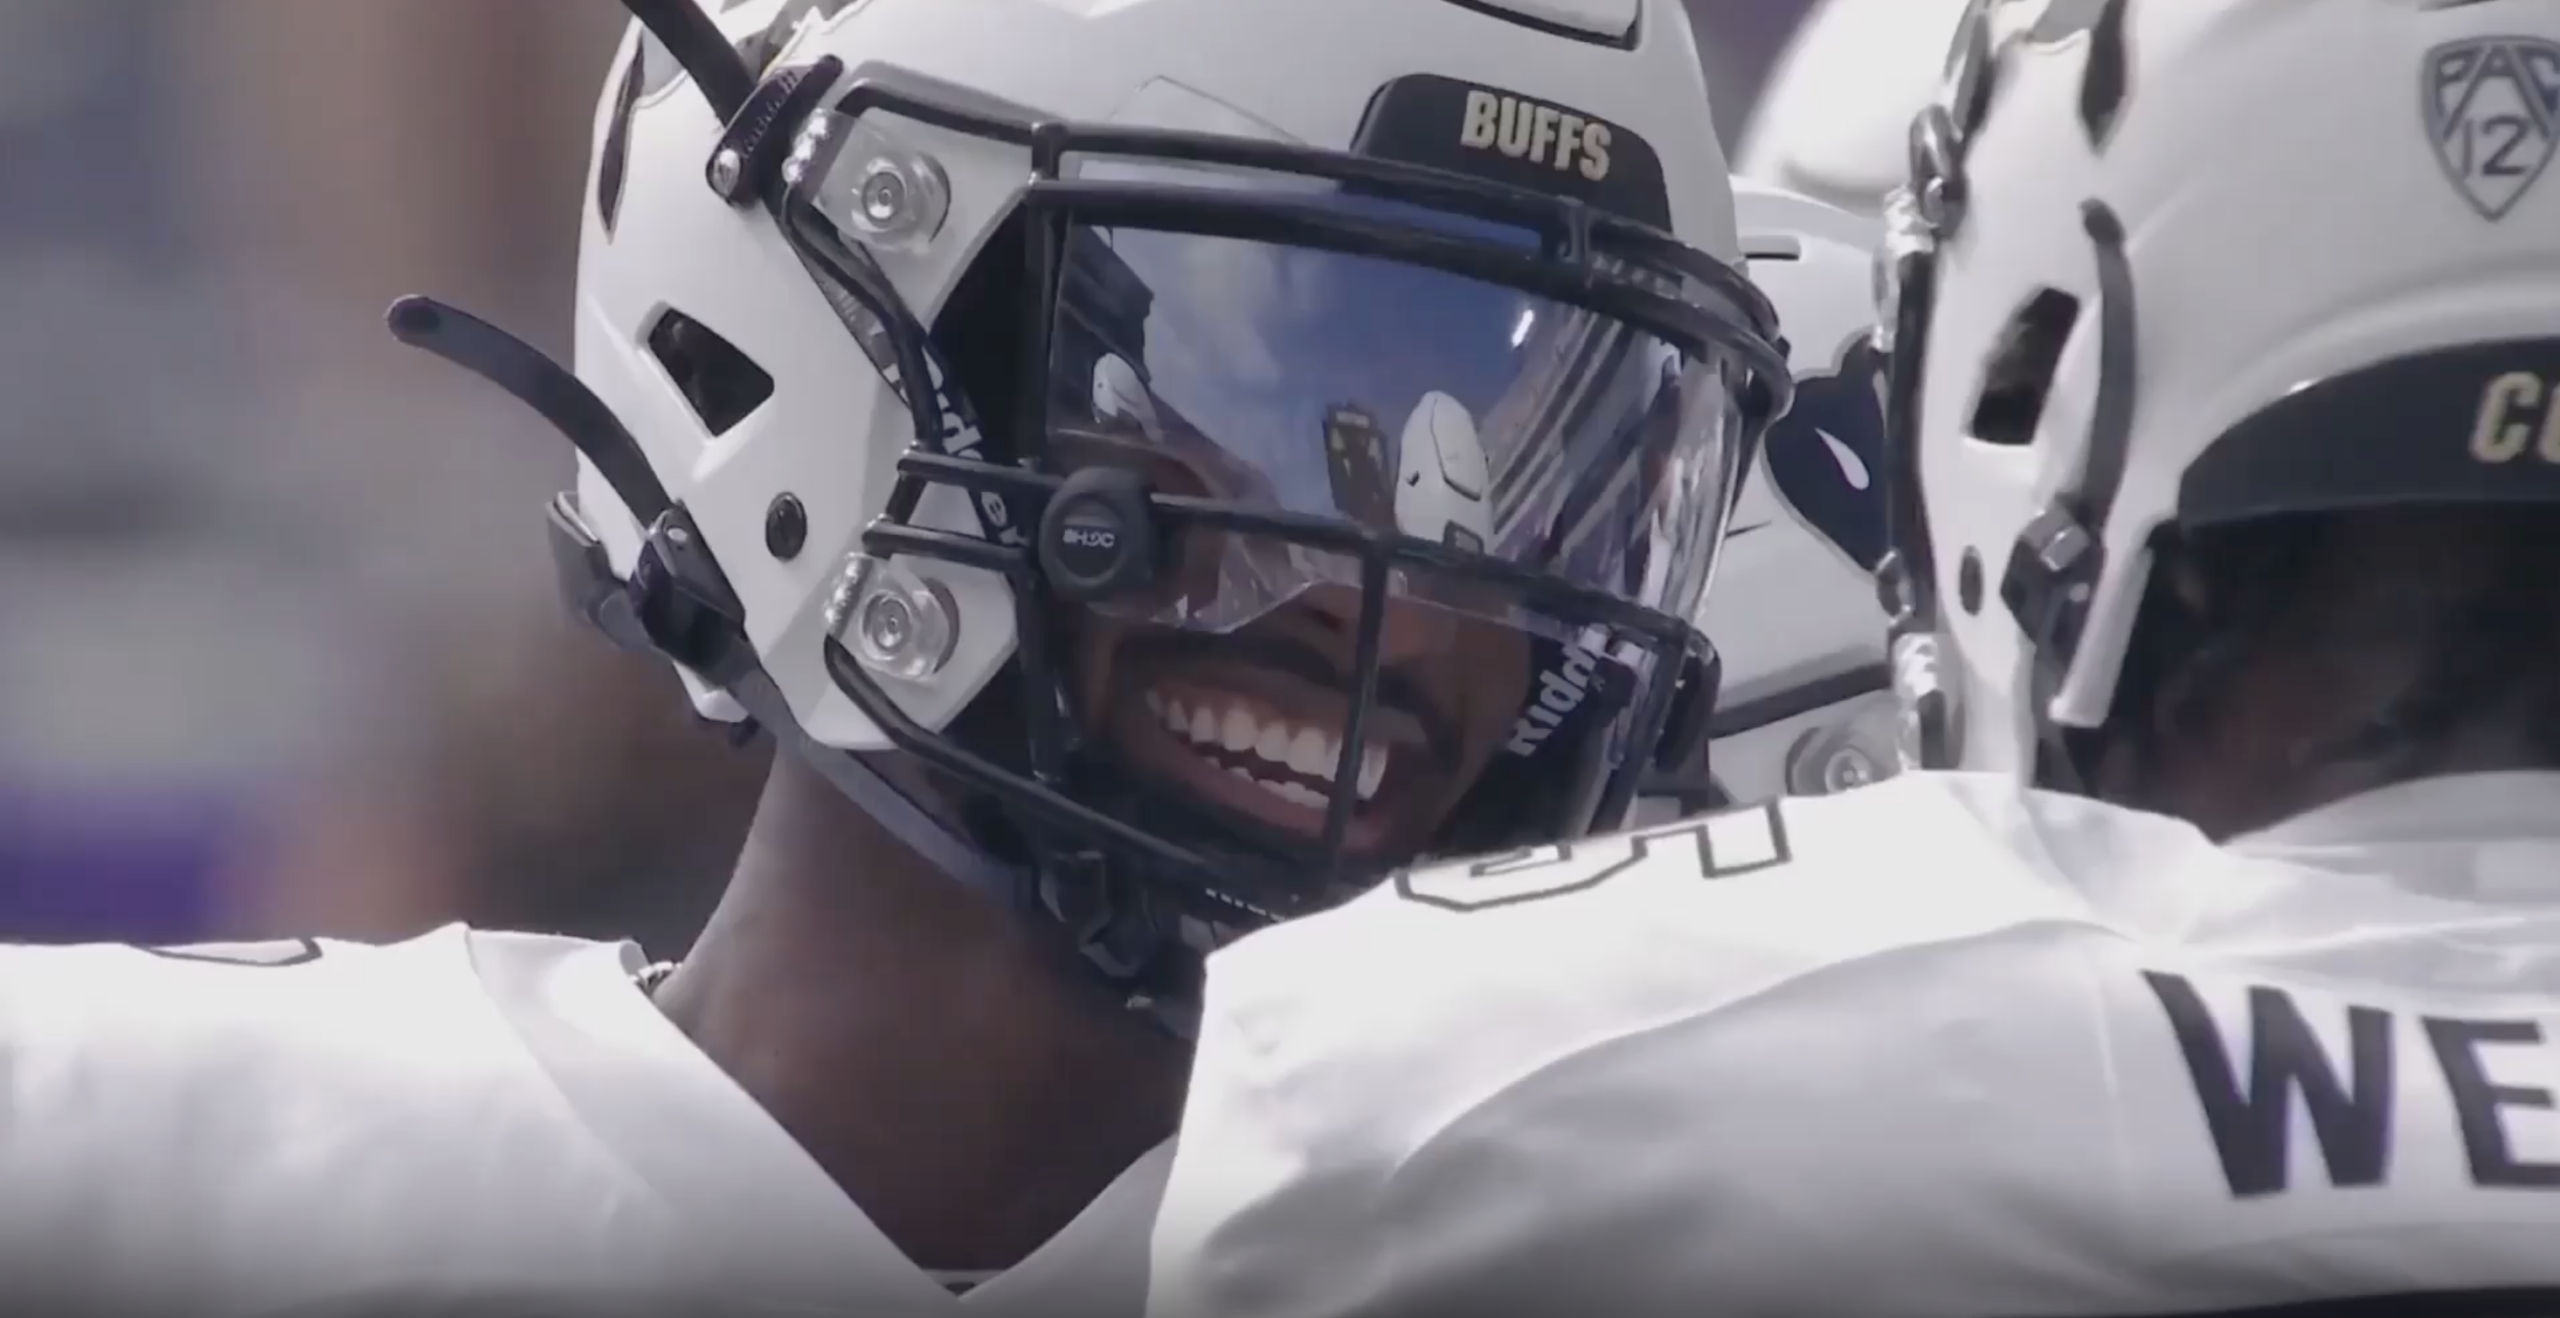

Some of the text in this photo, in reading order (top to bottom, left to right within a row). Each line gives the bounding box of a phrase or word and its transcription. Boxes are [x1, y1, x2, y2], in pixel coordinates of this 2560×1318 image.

[1461, 89, 1612, 181] BUFFS
[2461, 114, 2531, 180] 12
[2138, 968, 2560, 1199] WE
